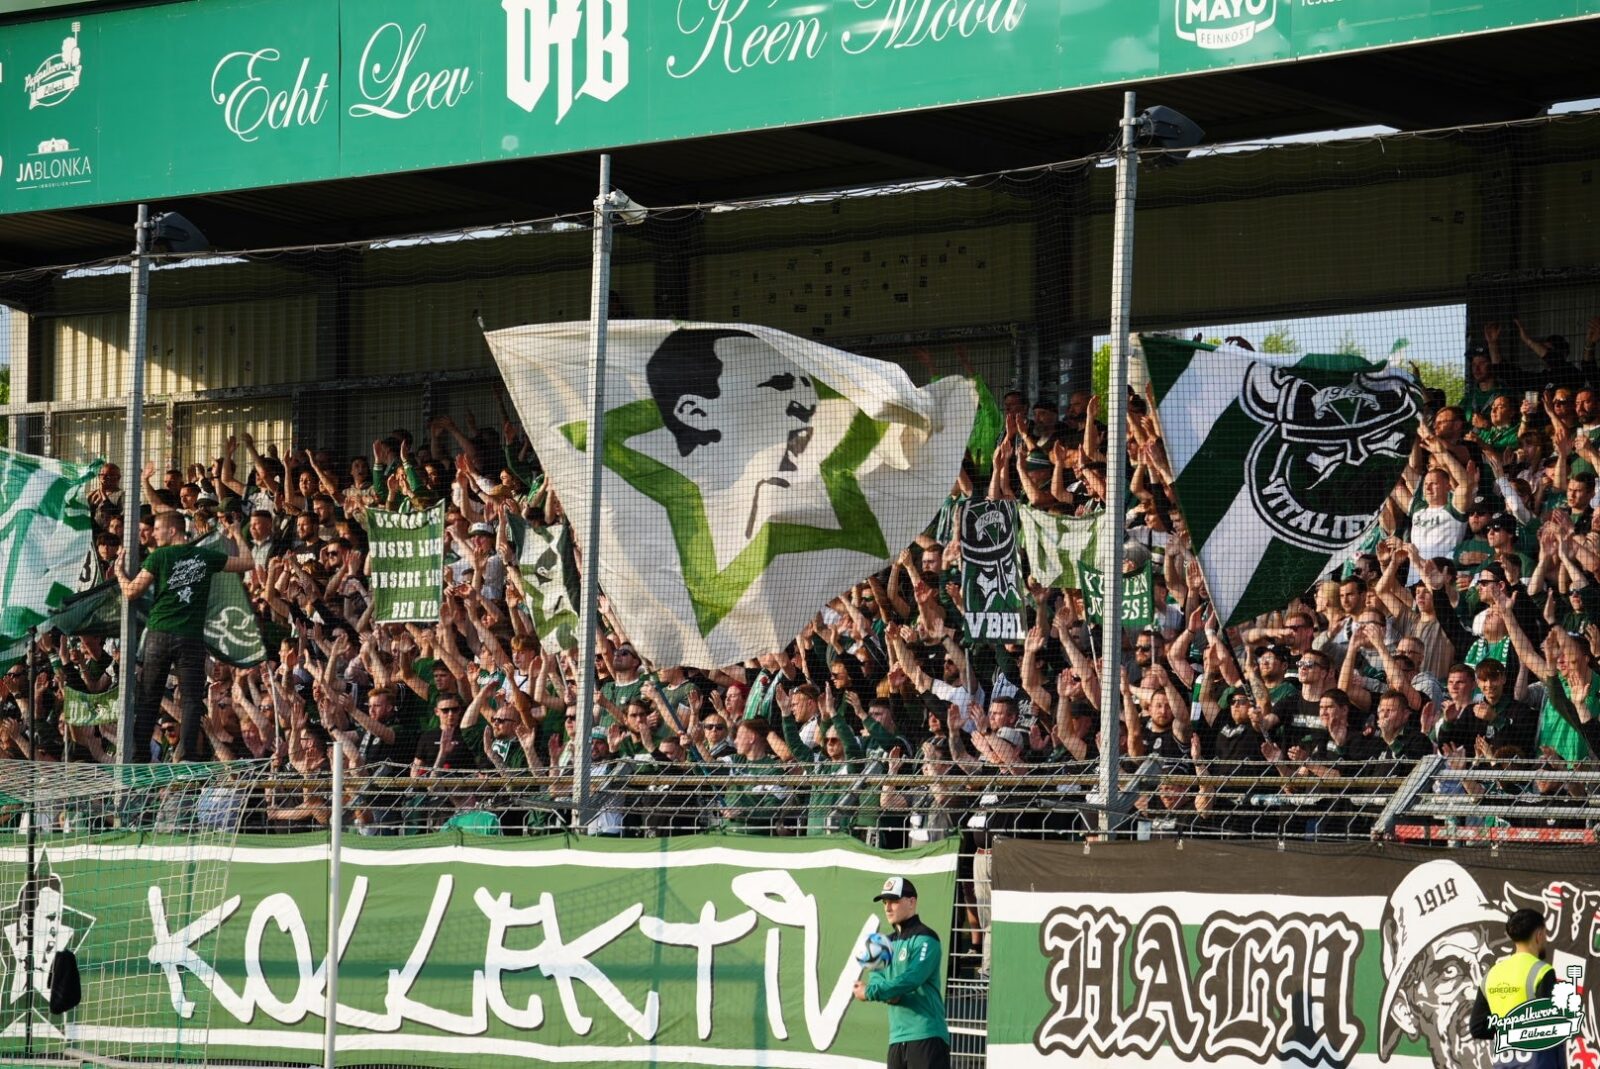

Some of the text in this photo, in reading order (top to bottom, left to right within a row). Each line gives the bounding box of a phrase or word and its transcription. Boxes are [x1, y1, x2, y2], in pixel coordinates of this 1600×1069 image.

[1200, 27, 1250, 44] FEINKOST
[211, 48, 329, 142] Echt
[349, 22, 473, 120] Leev
[666, 0, 828, 78] Keen
[16, 155, 92, 183] JABLONKA
[375, 511, 423, 529] ULTRAS
[369, 541, 413, 558] UNSER
[371, 571, 420, 588] UNSERE
[1414, 878, 1460, 917] 1919
